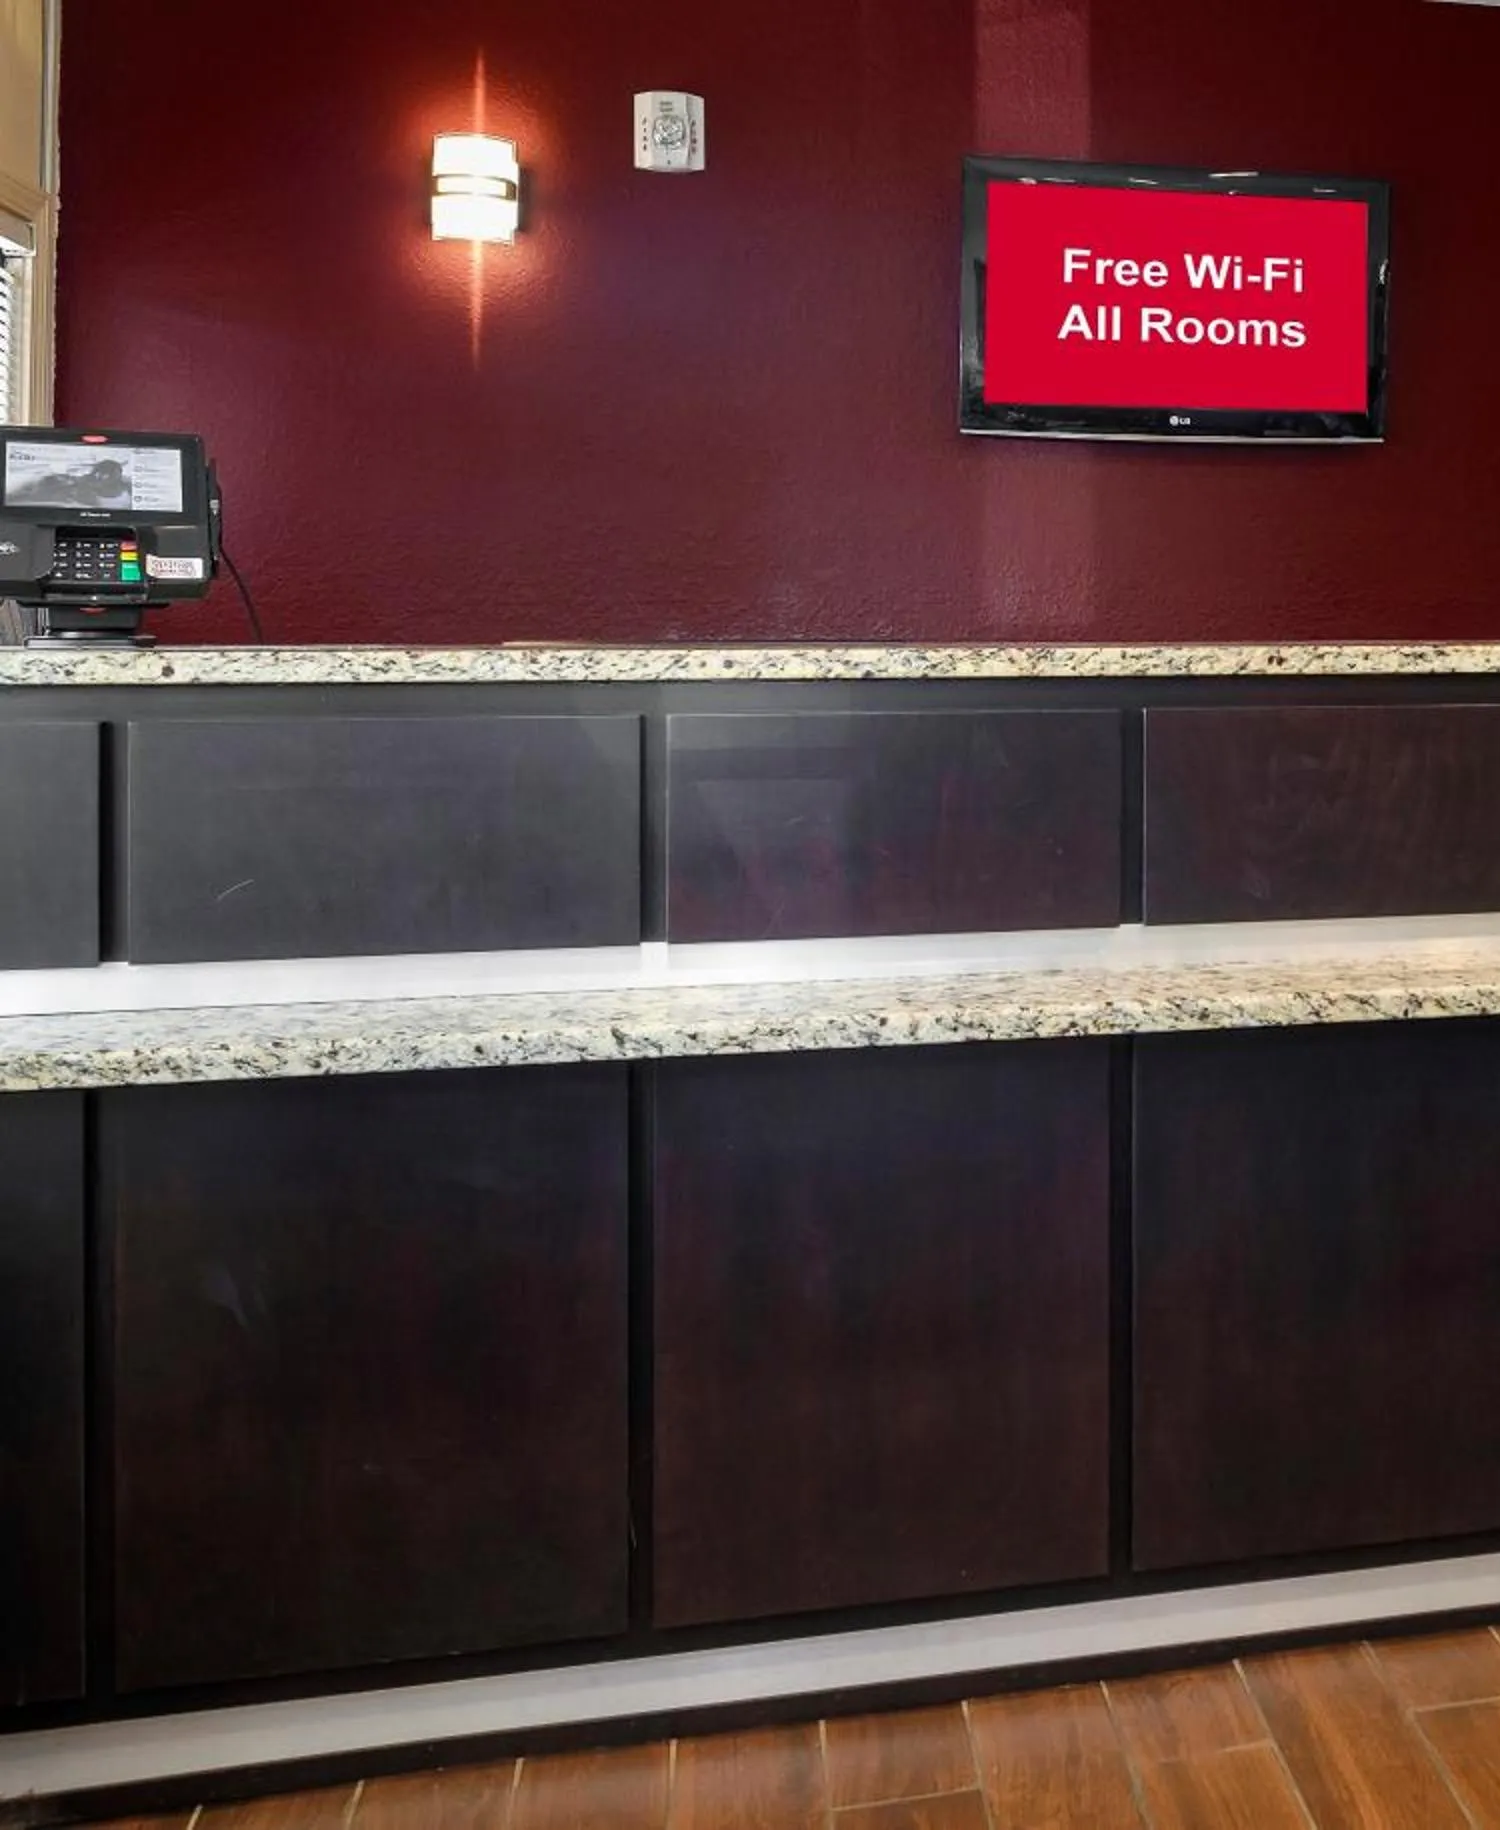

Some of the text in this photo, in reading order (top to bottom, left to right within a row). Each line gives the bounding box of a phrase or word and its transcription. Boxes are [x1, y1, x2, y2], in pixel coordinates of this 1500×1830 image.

[1063, 247, 1304, 293] Free Wi-Fi
[1057, 304, 1306, 347] All Rooms
